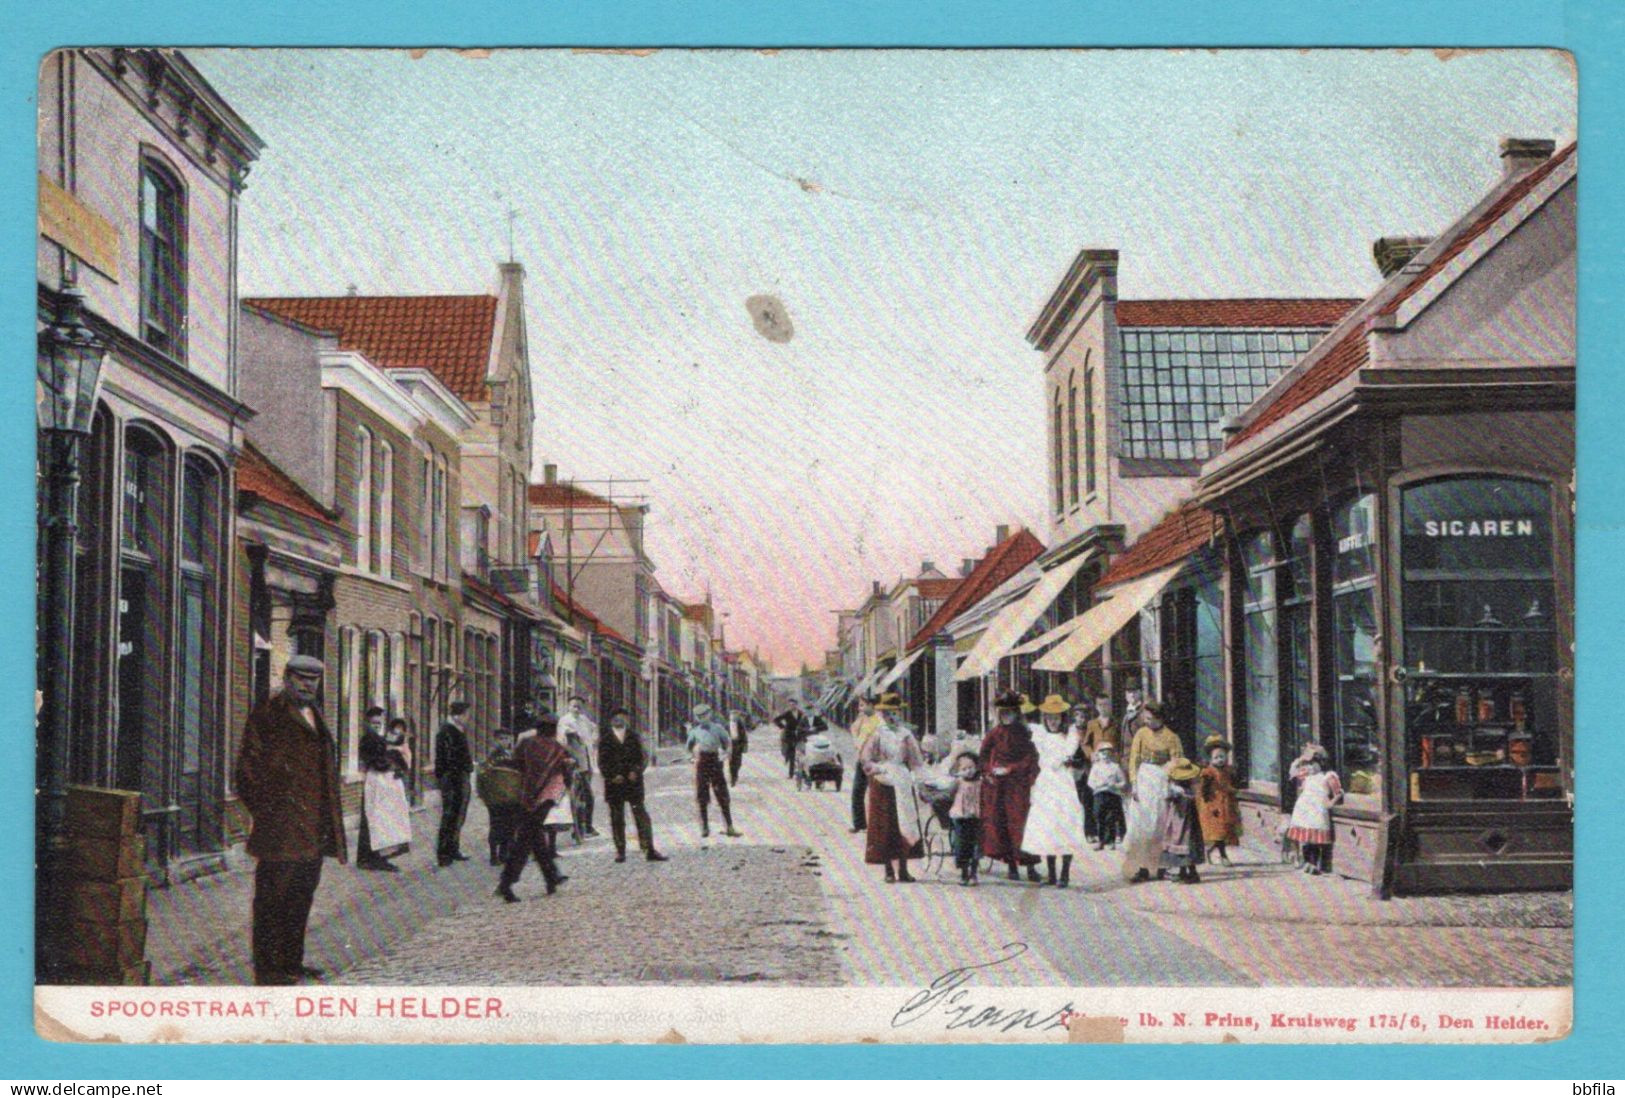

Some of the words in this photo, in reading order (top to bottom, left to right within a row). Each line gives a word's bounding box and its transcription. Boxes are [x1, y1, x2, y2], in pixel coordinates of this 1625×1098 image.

[295, 996, 358, 1019] DEN
[375, 996, 511, 1020] HELDER.
[1204, 1012, 1259, 1031] Prins,
[1270, 1012, 1358, 1032] Kruisweg
[1438, 1014, 1474, 1030] Den
[1485, 1014, 1550, 1031] Helder.
